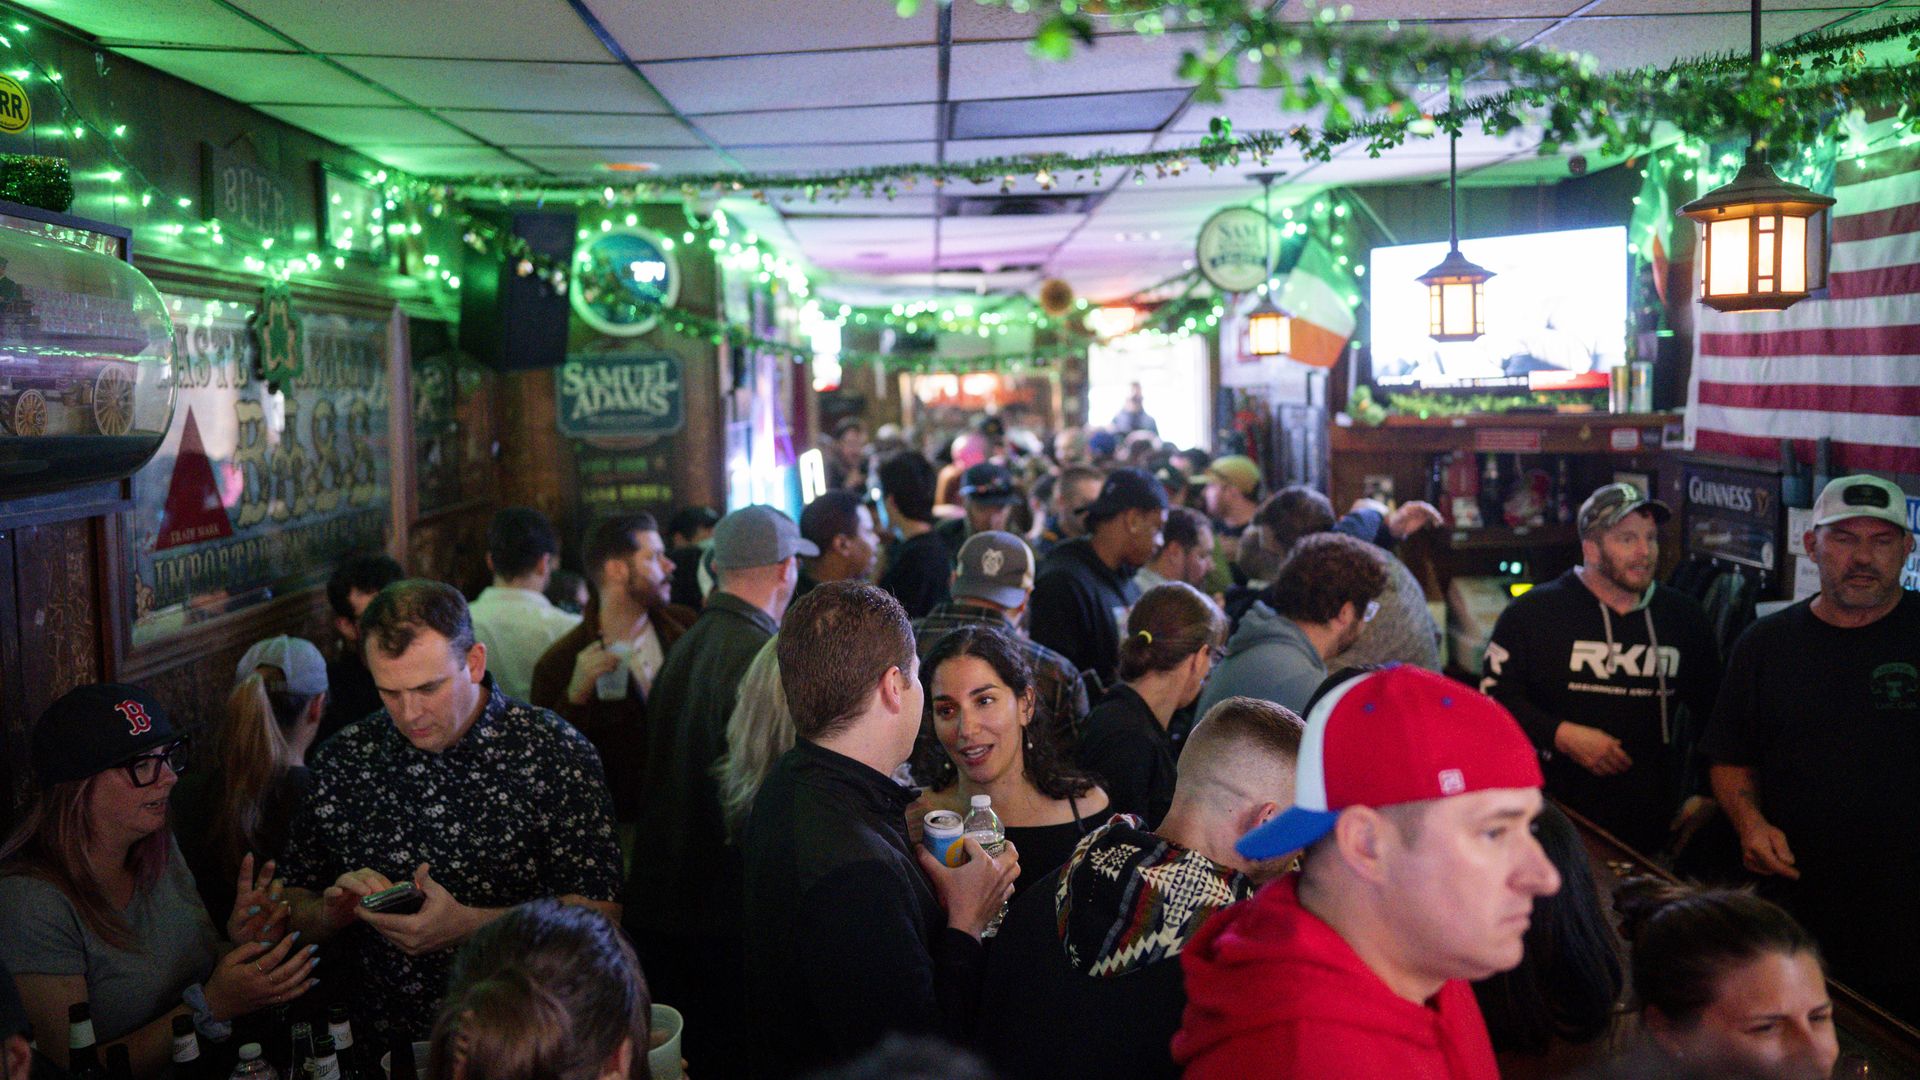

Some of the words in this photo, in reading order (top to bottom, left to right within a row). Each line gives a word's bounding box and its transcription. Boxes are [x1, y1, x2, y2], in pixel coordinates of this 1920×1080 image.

[563, 361, 679, 396] SAMUEL
[571, 385, 670, 419] ADAMS
[1688, 475, 1752, 512] GUINNESS
[114, 699, 152, 736] B
